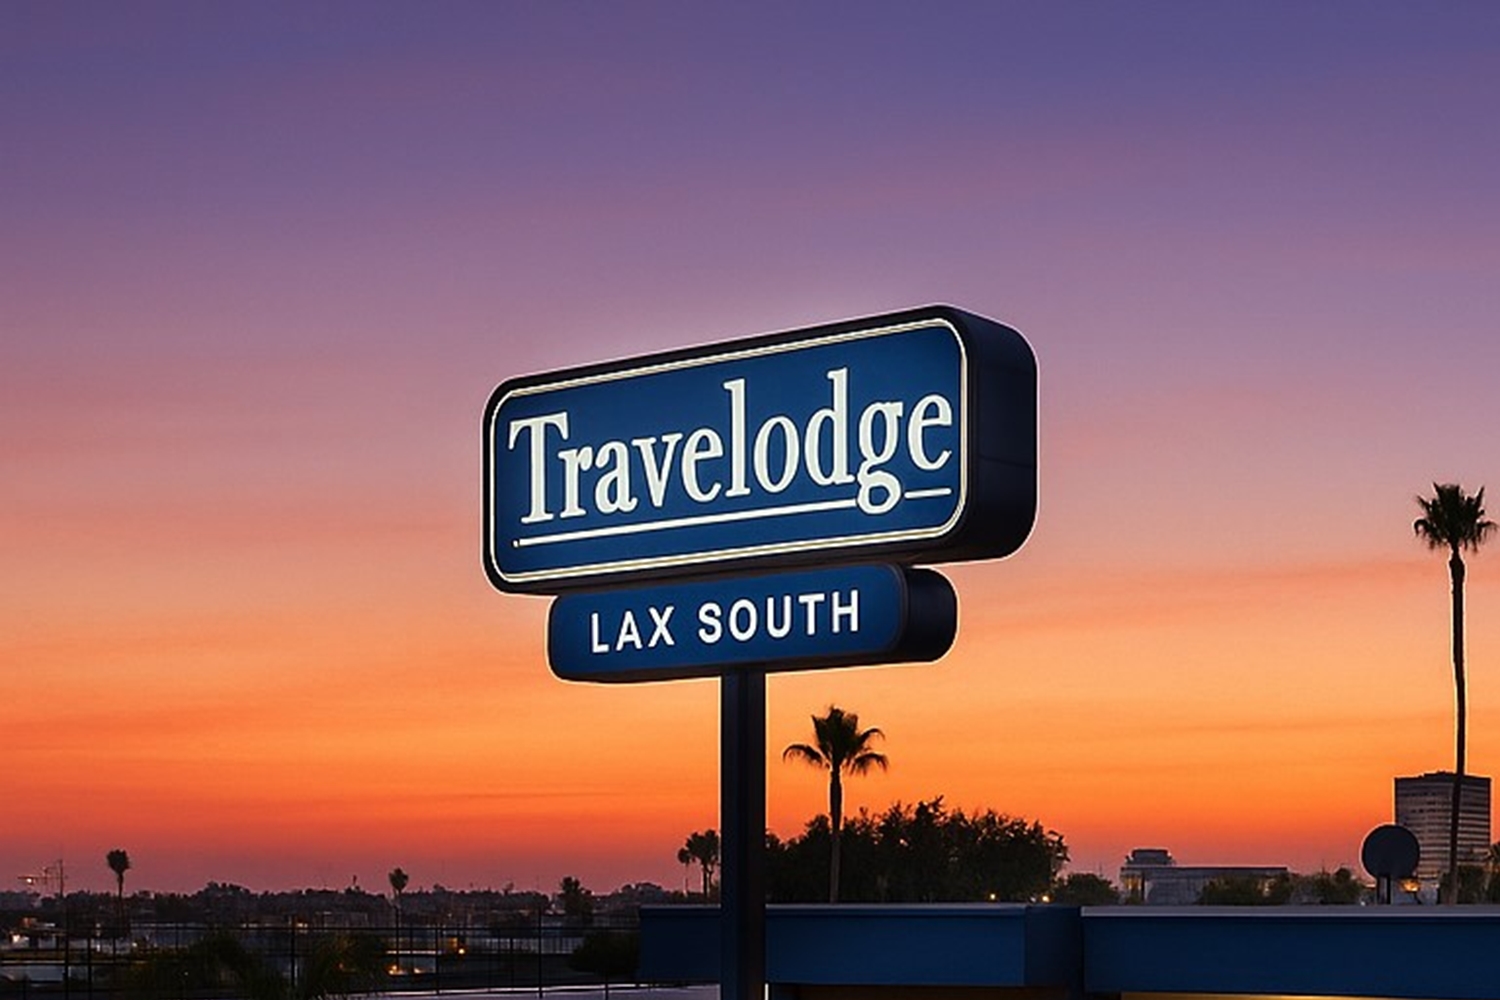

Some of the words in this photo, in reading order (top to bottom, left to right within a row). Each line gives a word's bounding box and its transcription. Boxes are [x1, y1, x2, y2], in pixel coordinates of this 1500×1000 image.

[508, 366, 953, 524] Travelodge
[590, 606, 675, 654] LAX
[698, 589, 860, 644] SOUTH
